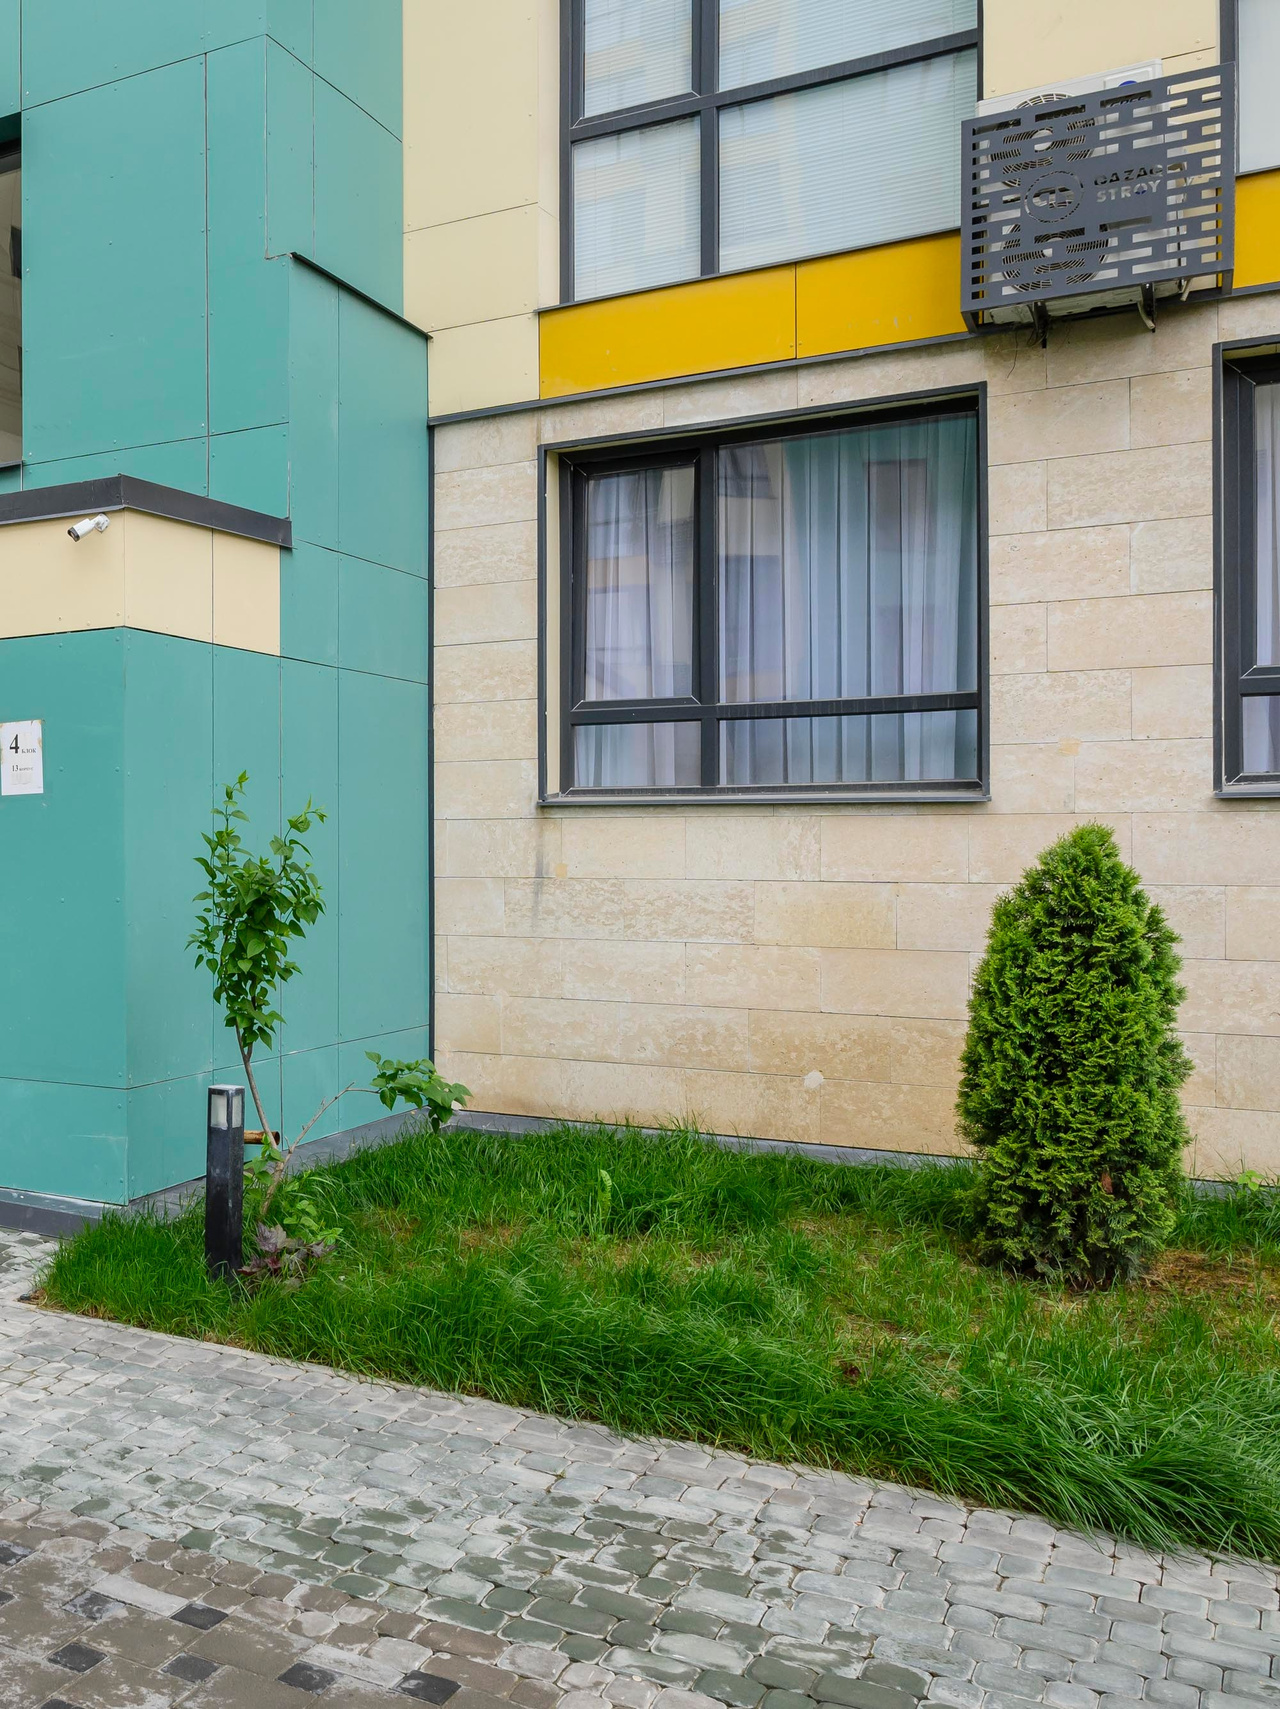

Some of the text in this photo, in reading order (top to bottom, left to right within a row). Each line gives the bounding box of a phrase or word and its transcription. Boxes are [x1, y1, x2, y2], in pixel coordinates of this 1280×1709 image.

[1096, 180, 1161, 203] STROY
[9, 733, 20, 754] 4
[12, 764, 19, 772] 13
